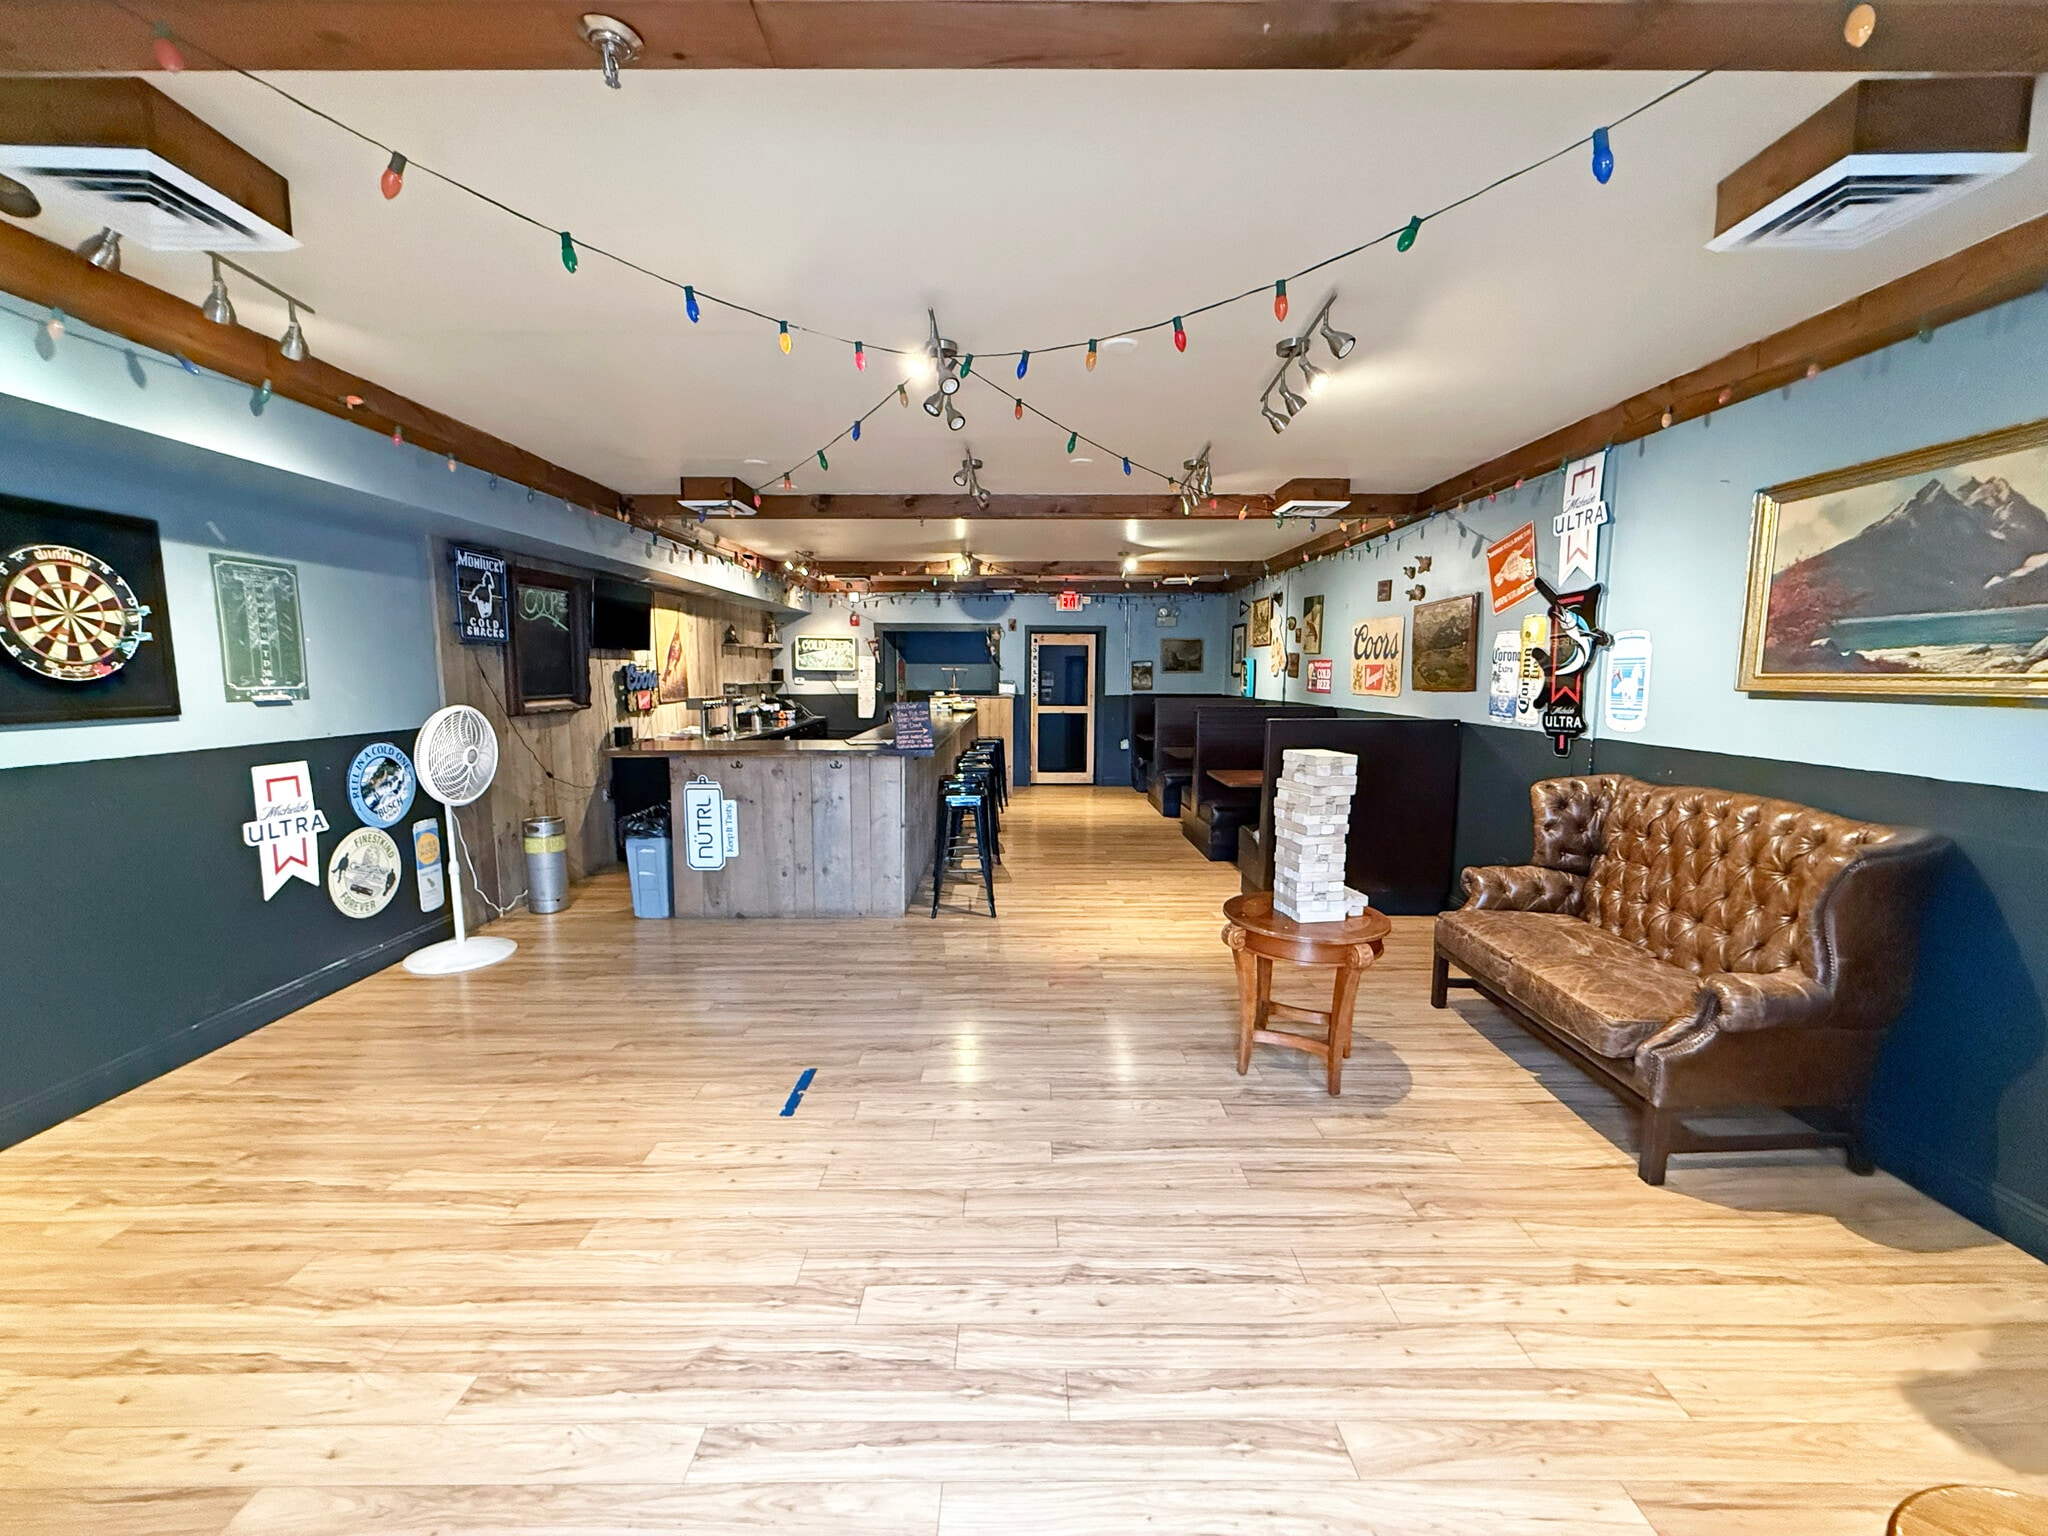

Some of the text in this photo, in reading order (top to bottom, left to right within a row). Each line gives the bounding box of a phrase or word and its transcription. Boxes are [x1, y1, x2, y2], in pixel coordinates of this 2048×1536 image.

[1555, 505, 1604, 534] ULTRA
[469, 617, 500, 628] COLD
[801, 639, 826, 651] COLD
[1353, 624, 1400, 661] Coors
[1316, 668, 1331, 679] COLD
[1518, 647, 1532, 714] Corona
[1316, 679, 1331, 690] BEER
[1545, 715, 1583, 729] ULTRA
[355, 759, 365, 770] IN
[364, 752, 372, 760] A
[371, 745, 395, 756] COLD
[395, 752, 411, 771] ONE
[259, 800, 310, 821] Michelob
[377, 796, 404, 818] BUSCH
[248, 813, 325, 843] ULTRA
[353, 833, 396, 860] FINESTKIND
[726, 833, 735, 853] Keep
[340, 891, 377, 912] FOREVER
